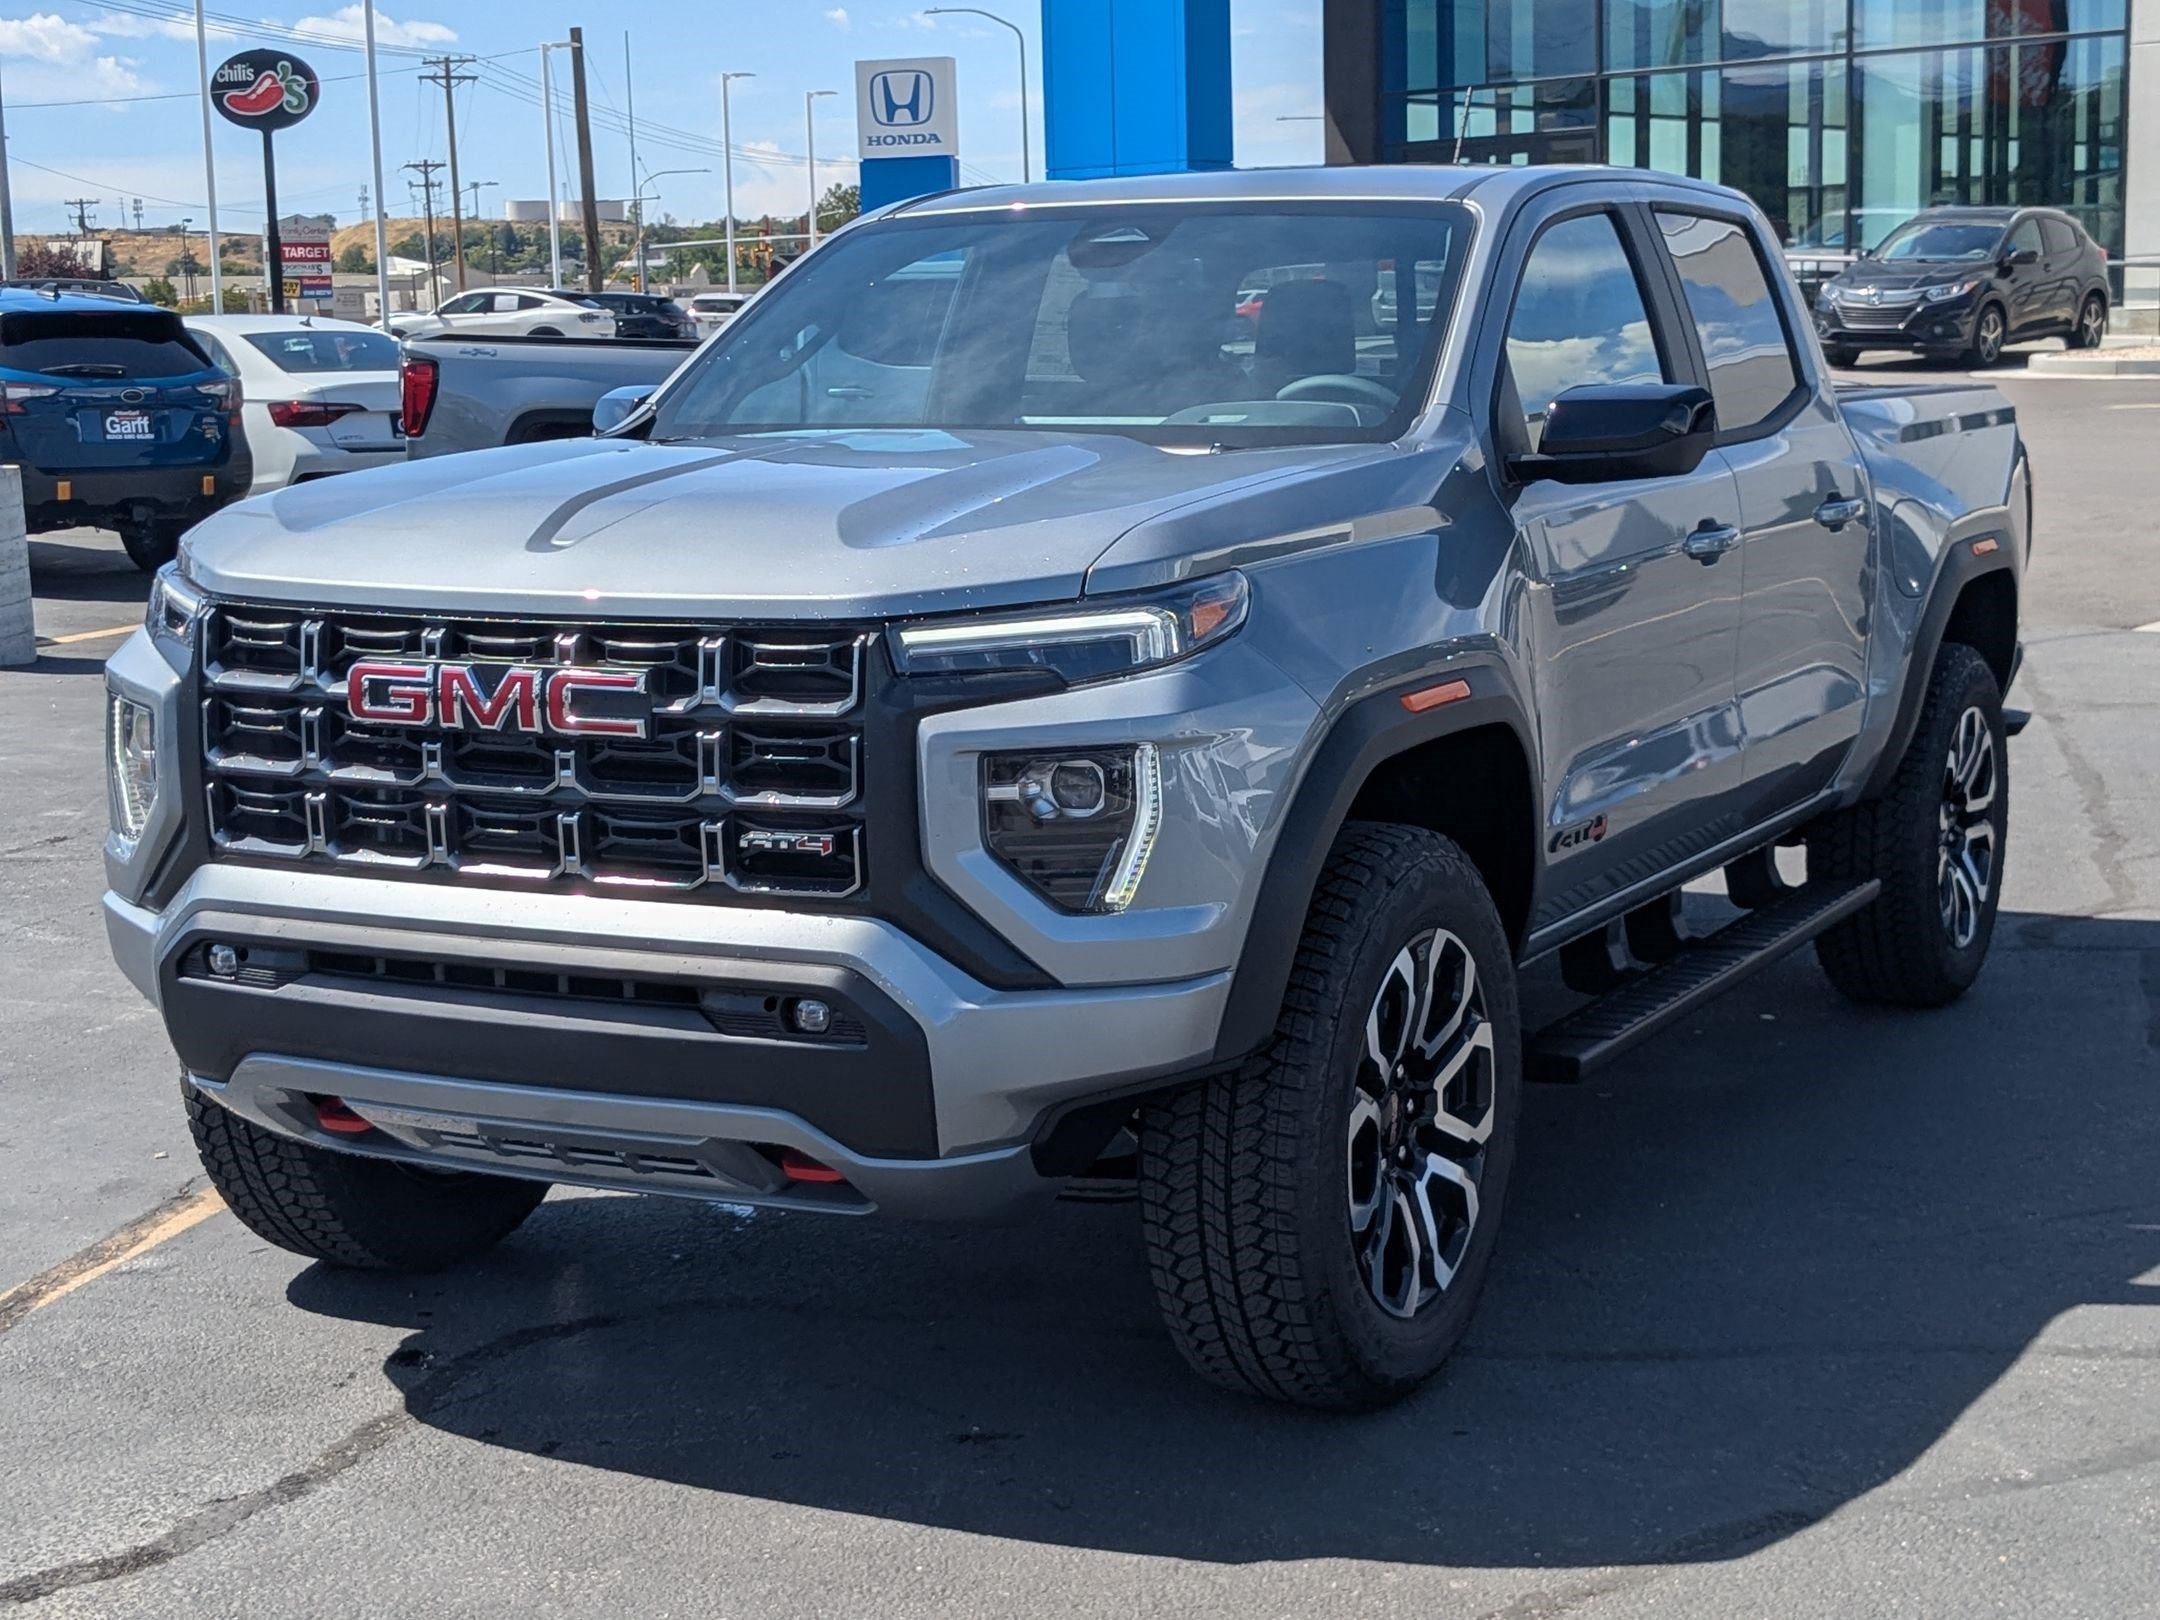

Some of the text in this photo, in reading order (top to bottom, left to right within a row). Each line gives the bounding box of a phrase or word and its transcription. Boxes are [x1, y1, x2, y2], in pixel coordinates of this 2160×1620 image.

[866, 133, 942, 147] HONDA
[283, 247, 328, 258] TARGET
[106, 416, 149, 433] Garff
[347, 662, 647, 739] GMC
[739, 830, 834, 857] AT4
